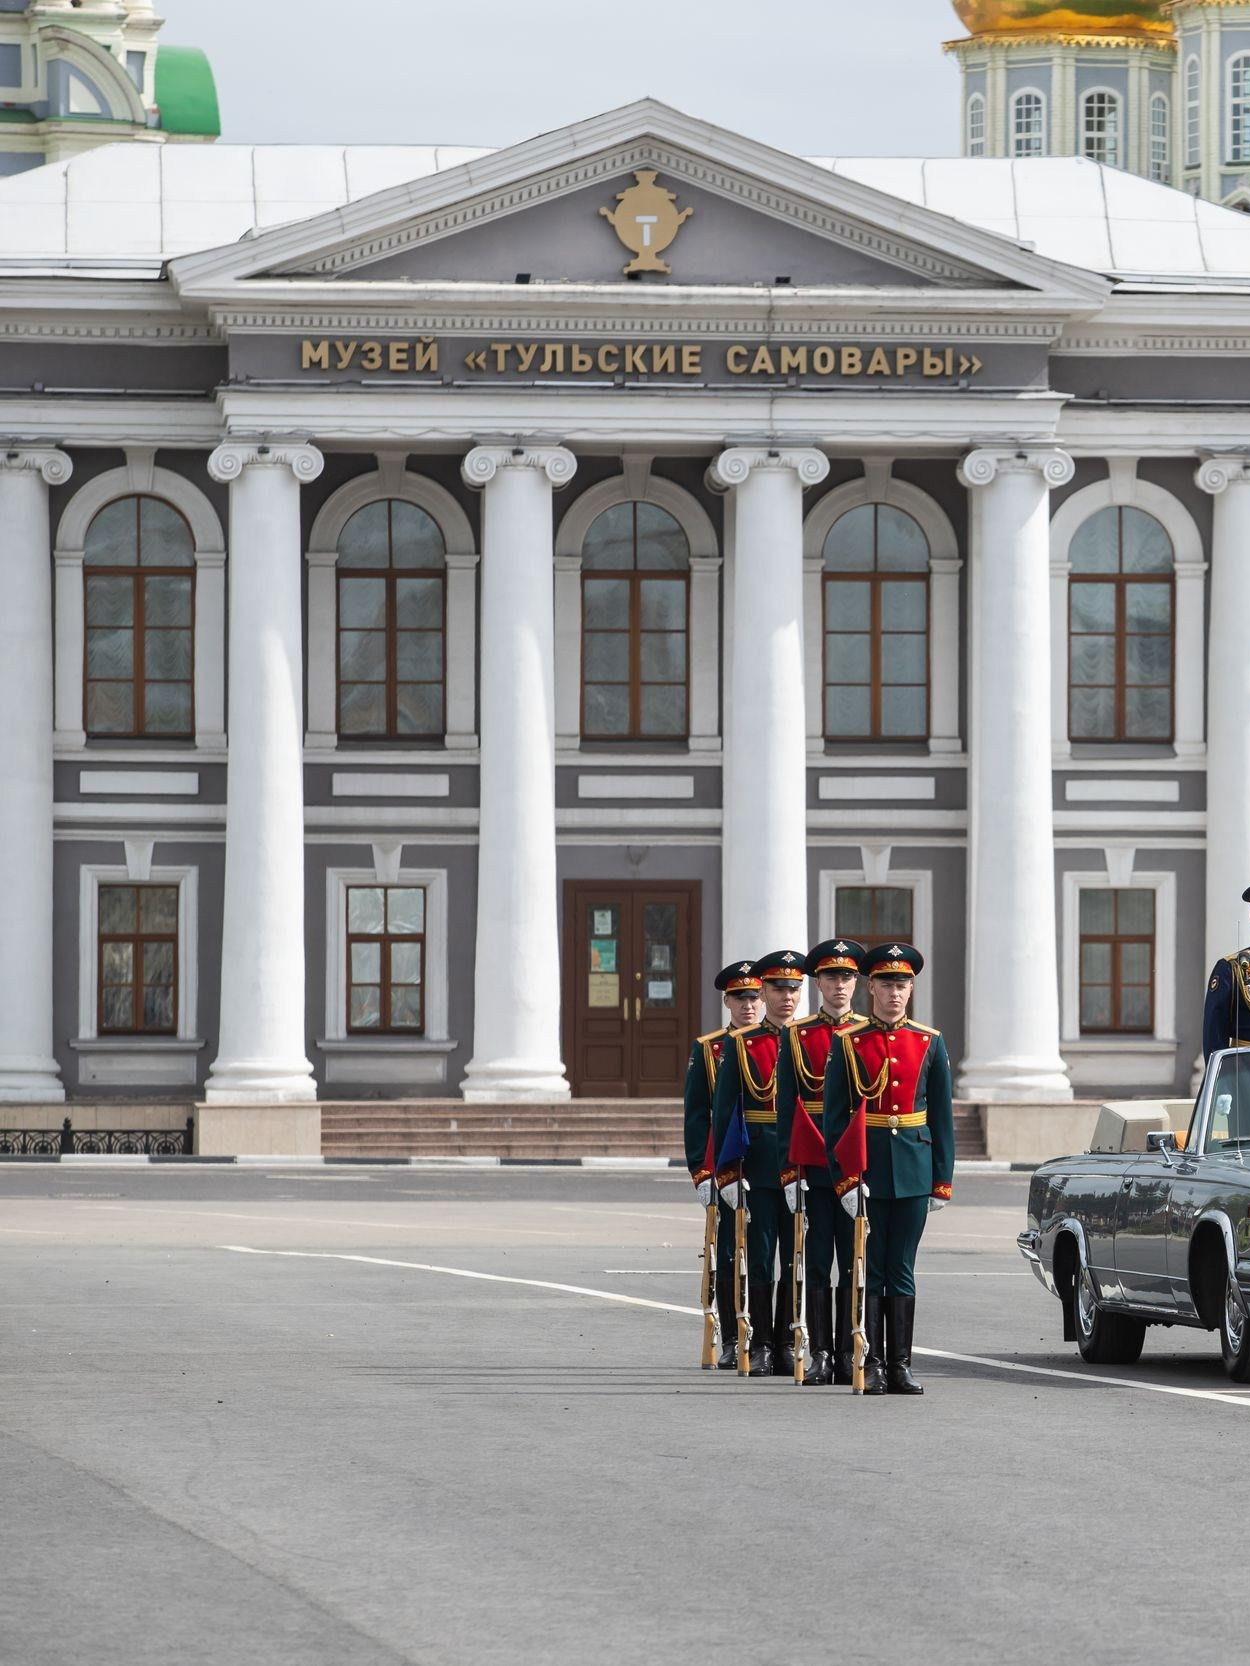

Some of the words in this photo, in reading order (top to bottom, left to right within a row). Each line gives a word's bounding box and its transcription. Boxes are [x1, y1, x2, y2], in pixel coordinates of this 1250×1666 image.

[301, 335, 439, 371] МУЗЕЙ
[464, 343, 703, 375] «ТУЛЬСКИЕ
[725, 345, 983, 377] САМОВАРЫ»
